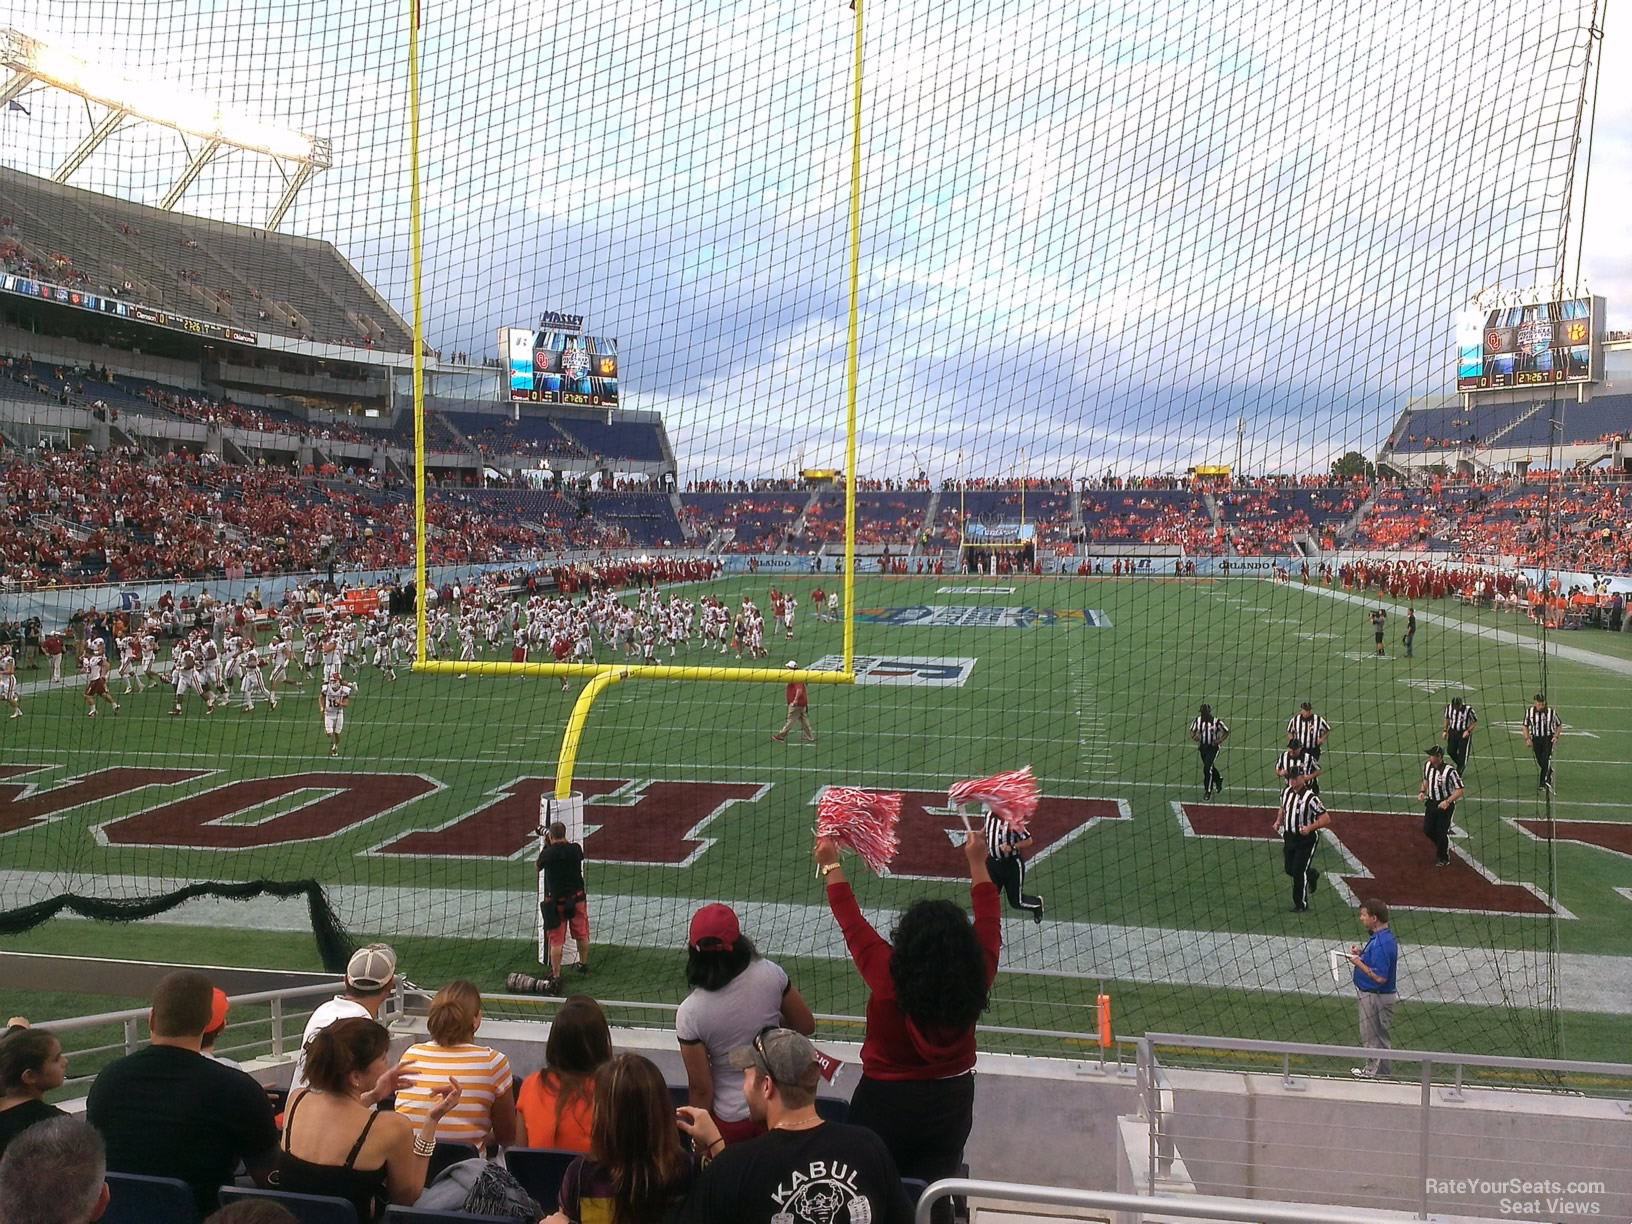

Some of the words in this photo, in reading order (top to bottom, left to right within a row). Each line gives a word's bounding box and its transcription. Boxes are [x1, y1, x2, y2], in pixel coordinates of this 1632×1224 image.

[542, 310, 584, 326] MASSEY
[1519, 373, 1542, 383] 27:26
[564, 393, 584, 403] 27:26
[770, 1160, 858, 1205] KABUL
